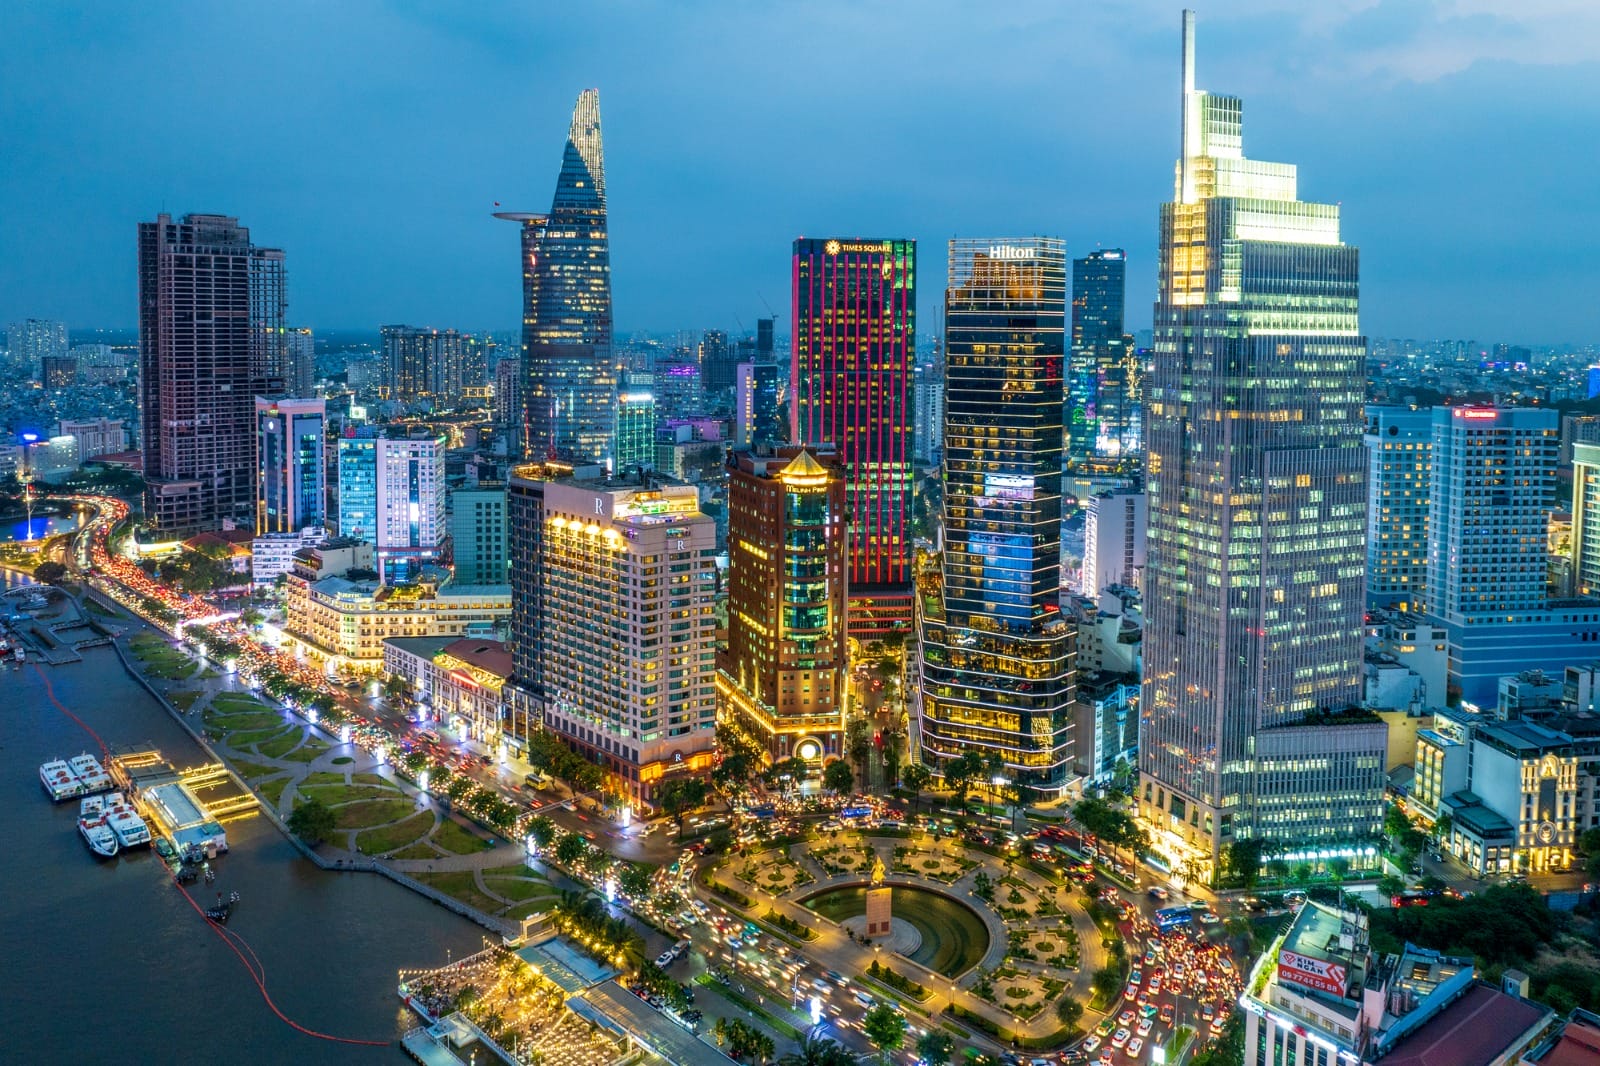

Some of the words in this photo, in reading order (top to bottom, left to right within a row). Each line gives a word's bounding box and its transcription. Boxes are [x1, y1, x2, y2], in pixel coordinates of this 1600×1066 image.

[842, 244, 862, 252] TIMES
[864, 244, 891, 253] SQUARE
[990, 245, 1034, 258] Hilton
[595, 497, 604, 514] R
[677, 540, 685, 550] R
[1297, 957, 1314, 966] KIM
